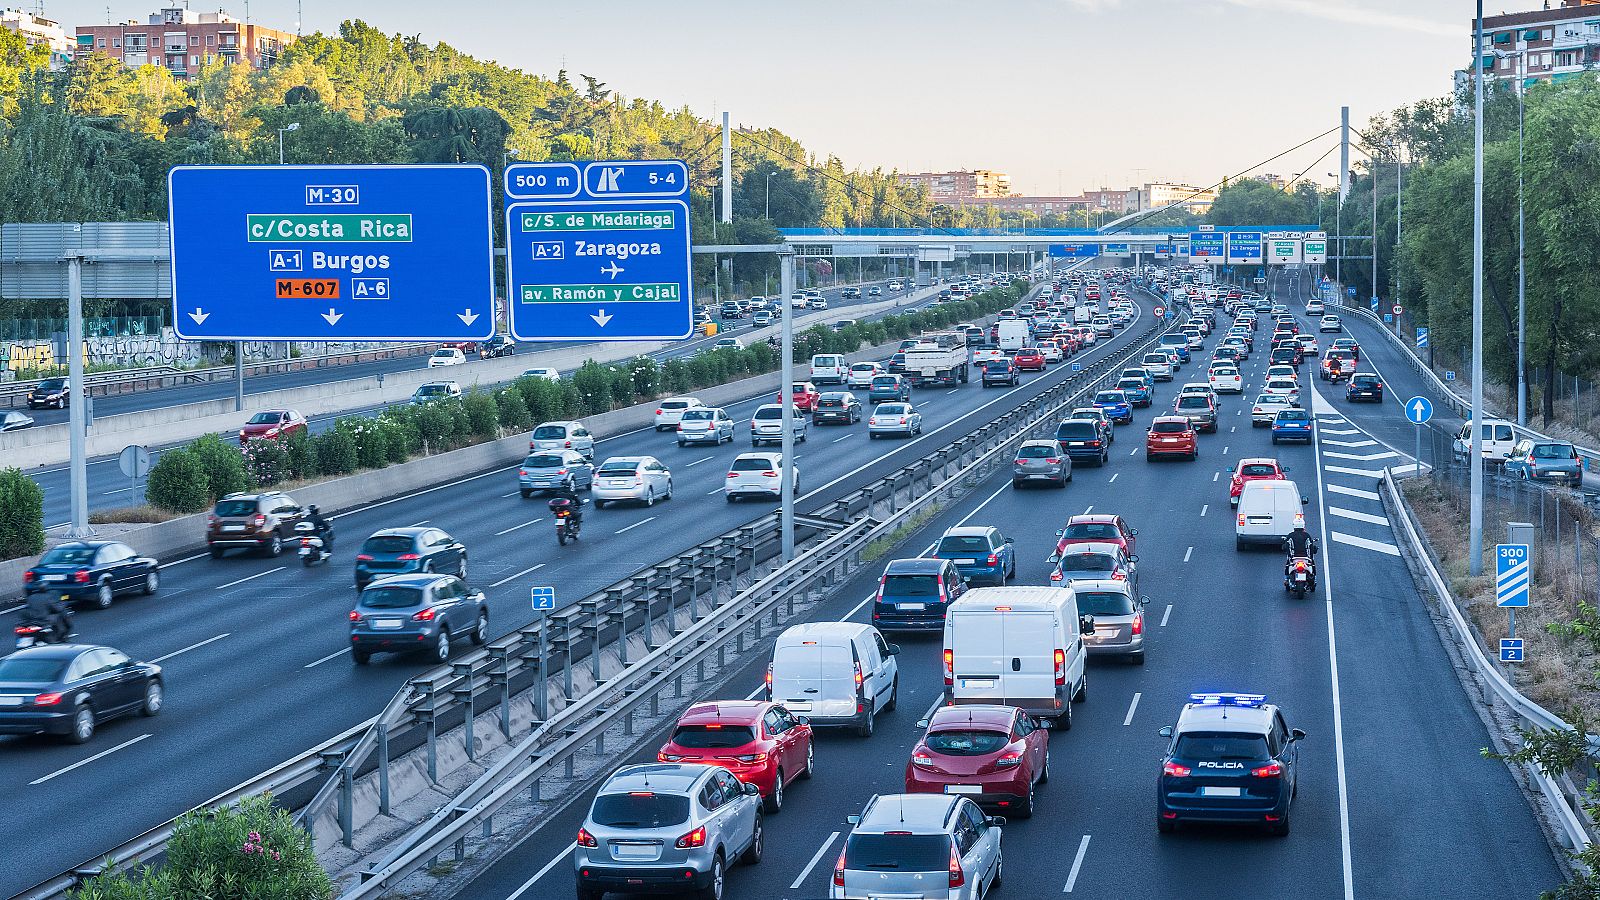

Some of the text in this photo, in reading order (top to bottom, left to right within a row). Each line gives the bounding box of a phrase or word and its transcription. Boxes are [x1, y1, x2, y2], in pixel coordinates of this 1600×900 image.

[517, 174, 570, 187] 500 m
[649, 172, 676, 185] 5-4
[309, 188, 356, 203] M-30
[252, 219, 409, 238] c/Costa Rica
[565, 215, 585, 227] de
[592, 213, 672, 229] Madariaga
[535, 240, 662, 260] A-2 Zaragoza
[273, 251, 390, 273] A-1 Burgos
[278, 281, 387, 297] M-607 A-6
[524, 285, 677, 302] av. Ramón y Cajal
[1500, 548, 1524, 558] 300
[1508, 558, 1518, 566] m
[539, 597, 548, 607] 2
[1507, 650, 1516, 659] 2
